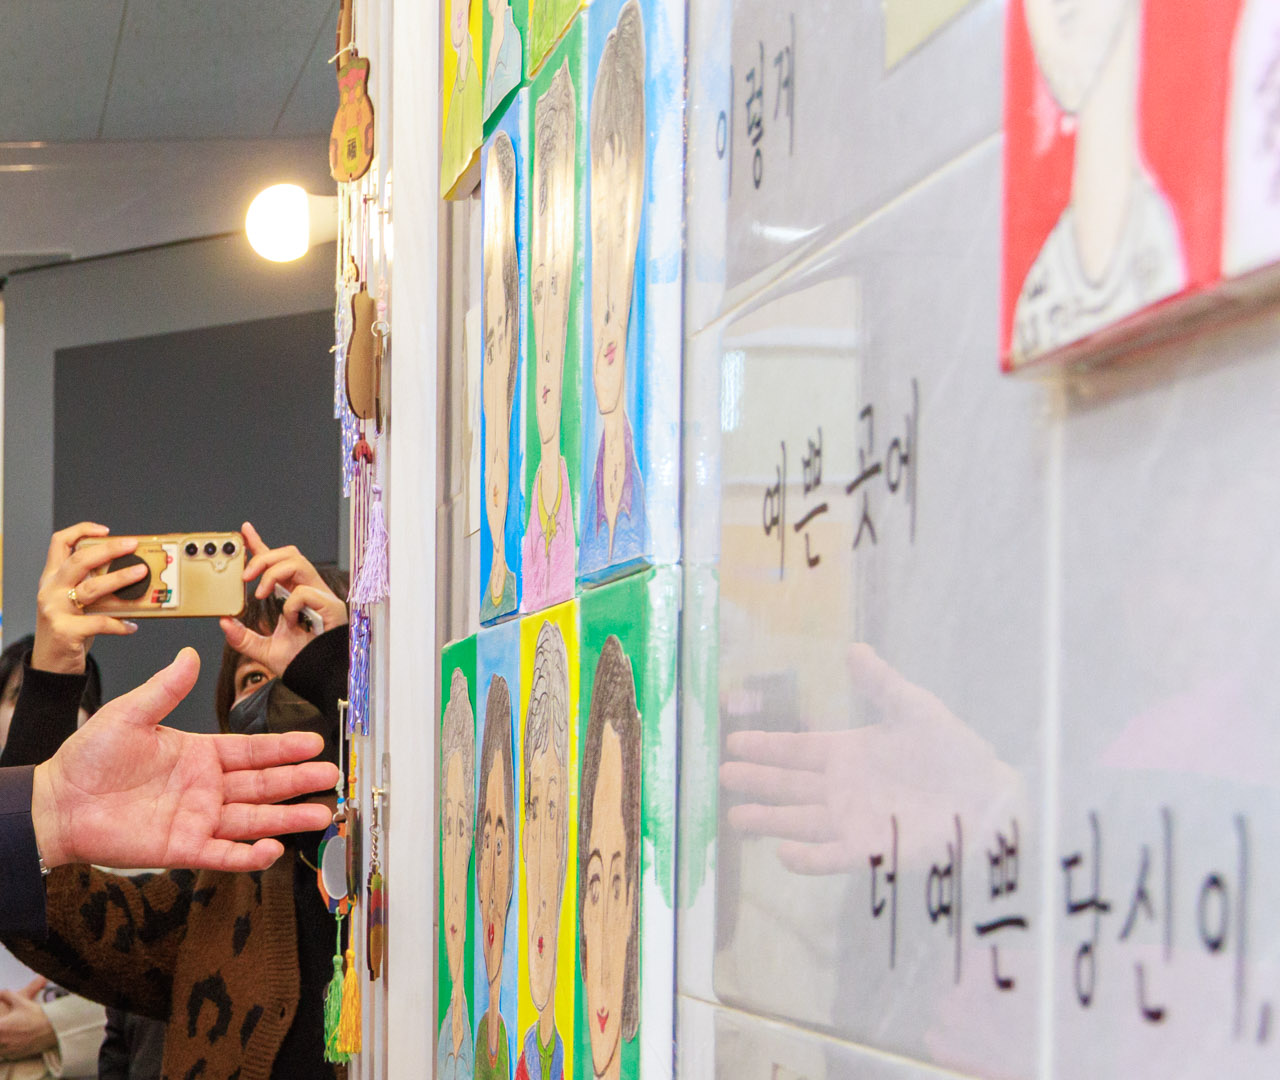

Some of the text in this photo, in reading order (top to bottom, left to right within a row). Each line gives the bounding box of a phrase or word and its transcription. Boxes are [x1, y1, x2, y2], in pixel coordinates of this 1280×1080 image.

[715, 11, 796, 198] 이렇게
[762, 377, 920, 582] 예쁜 곳에
[869, 813, 899, 970] 더
[926, 812, 1029, 990] 예쁜
